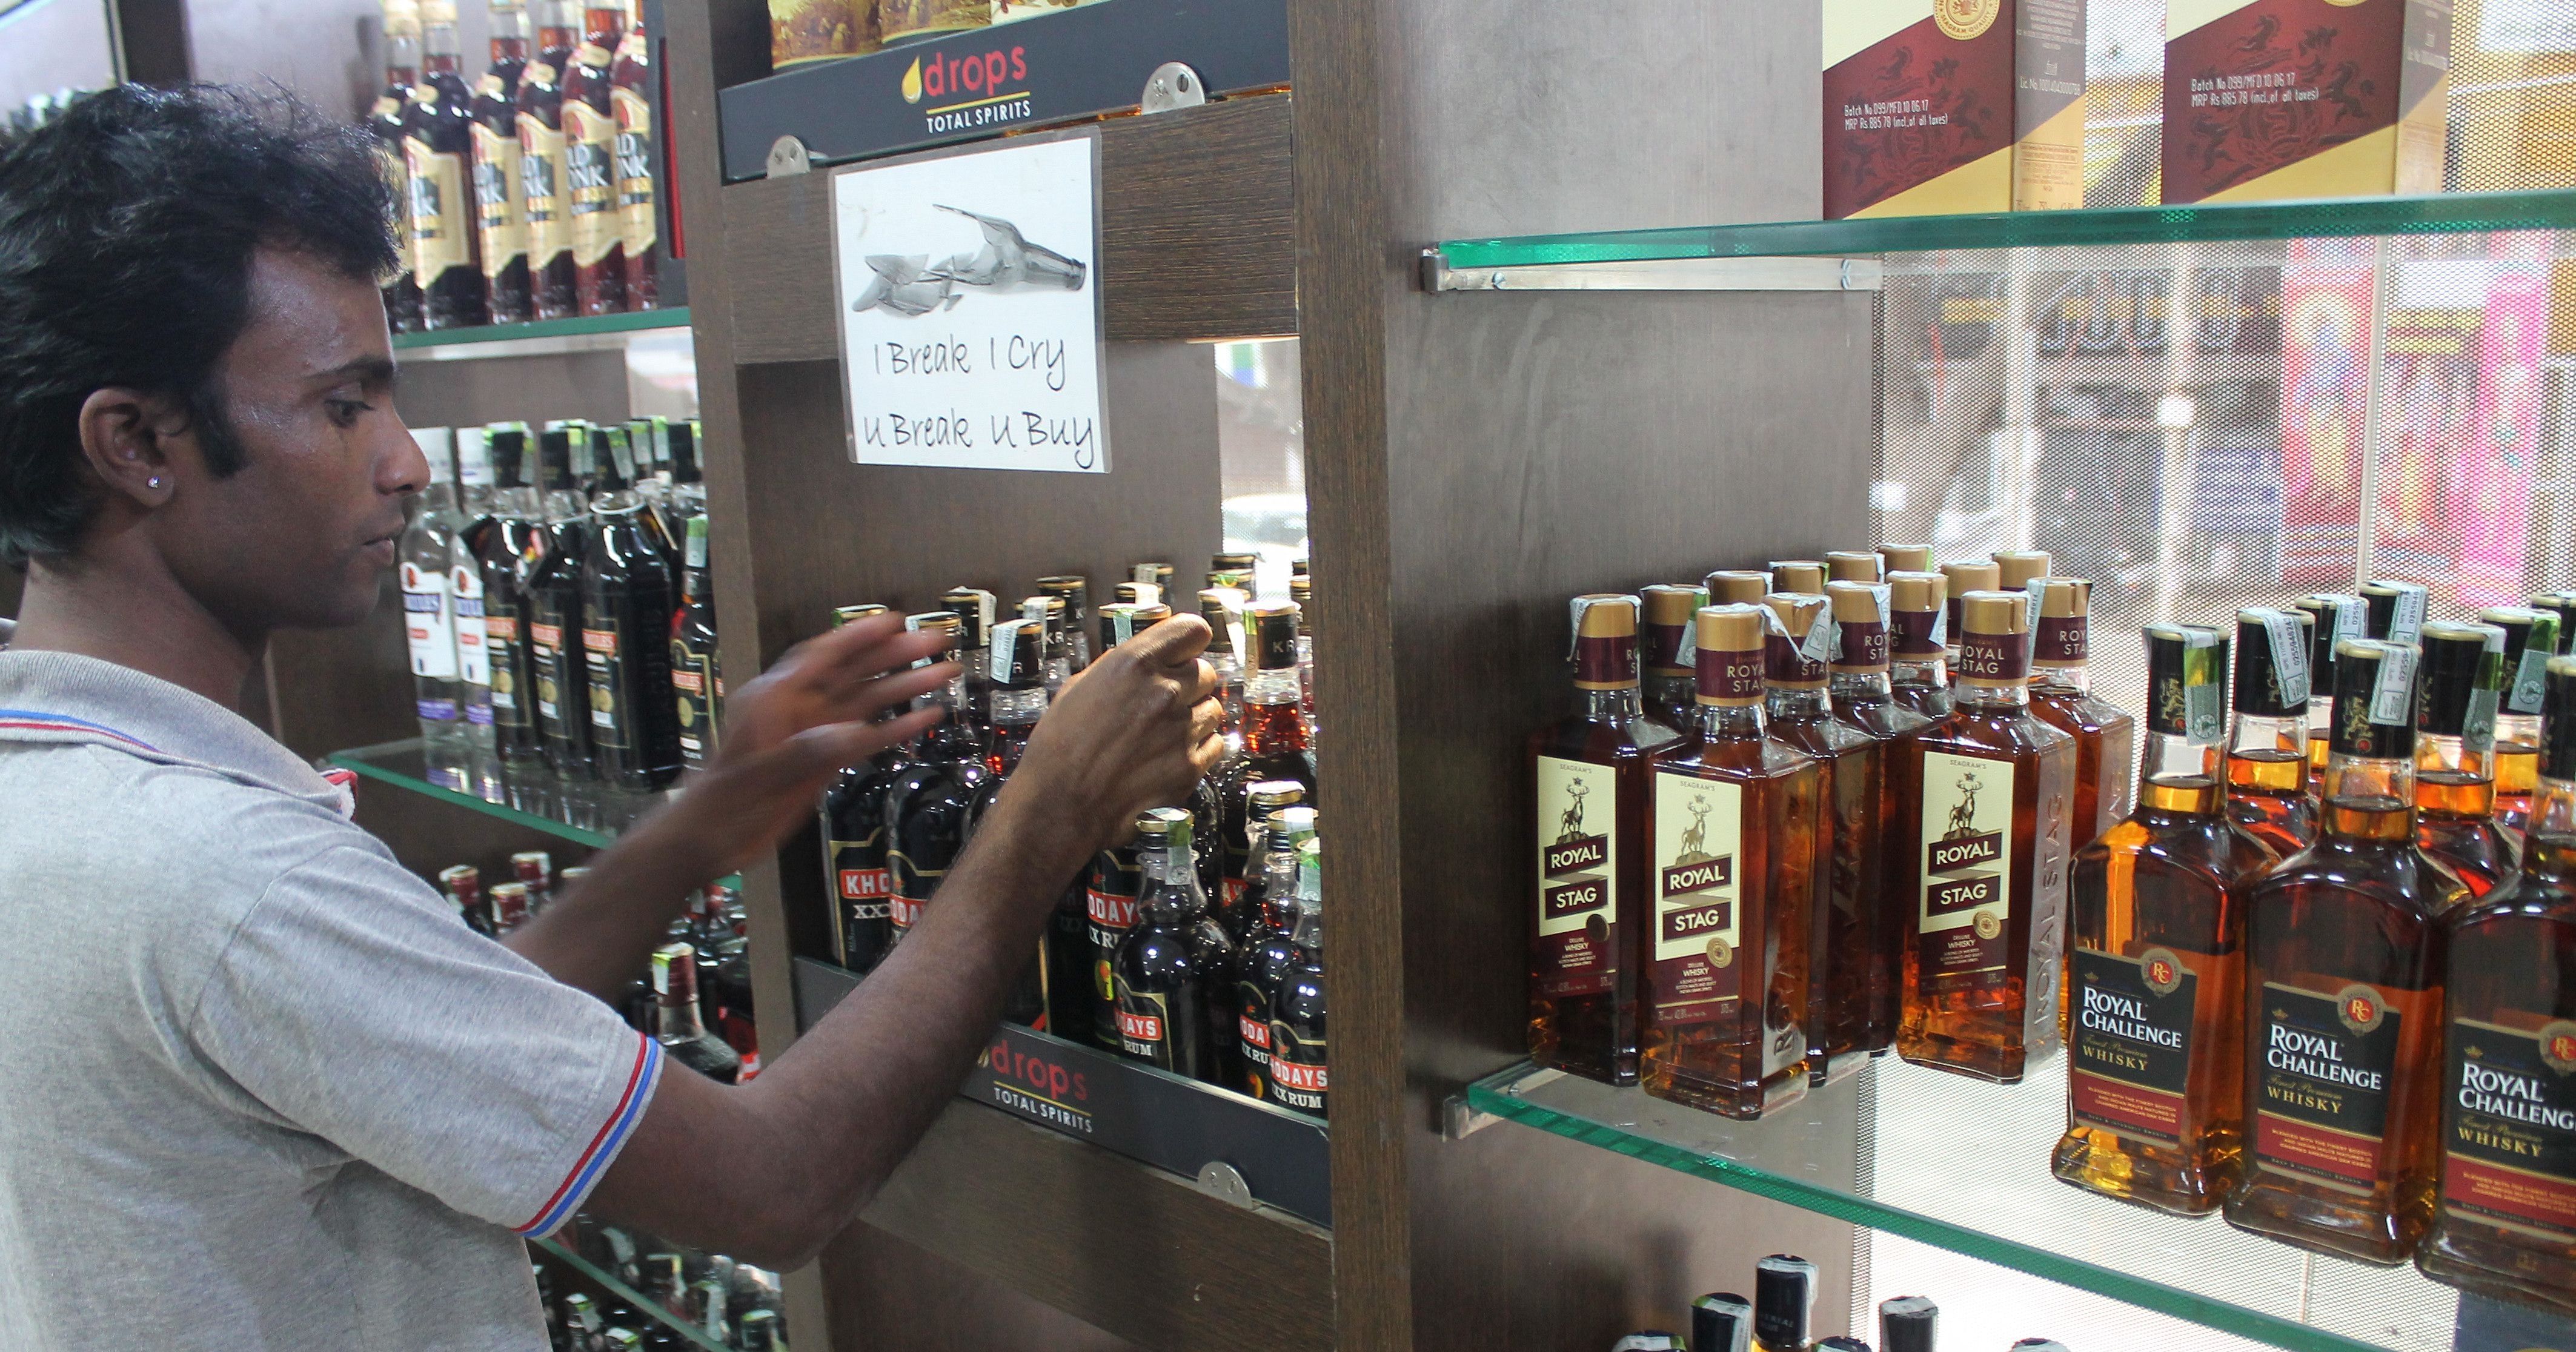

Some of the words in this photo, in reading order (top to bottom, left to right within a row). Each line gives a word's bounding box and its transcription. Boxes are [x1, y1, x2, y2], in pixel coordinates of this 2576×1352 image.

[924, 45, 1027, 97] drops
[926, 111, 972, 134] TOTAL
[975, 100, 1031, 125] SPIRITS
[874, 343, 880, 374] I
[886, 333, 971, 375] Break
[989, 337, 995, 370] I
[1007, 335, 1066, 391] Cry
[889, 408, 972, 448] Break
[1021, 411, 1094, 469] Buy
[2059, 629, 2086, 642] ROY
[2063, 643, 2086, 655] STA
[1727, 664, 1765, 678] ROYA
[1801, 664, 1827, 676] STA
[1962, 658, 1999, 674] STAG
[1560, 763, 1592, 775] SEAGRAM'S
[1950, 760, 1987, 770] SEAGRAM'S
[1680, 780, 1716, 792] SEAGRAM'S
[1551, 845, 1602, 869] ROYAL
[1936, 841, 1995, 865] ROYAL
[1670, 865, 1725, 890] ROYAL
[1556, 887, 1597, 909] STAG
[1940, 883, 1988, 906] STAG
[1675, 909, 1720, 932] STAG
[1682, 967, 1710, 977] WHISKY
[2084, 986, 2147, 1021] ROYAL
[2082, 1010, 2182, 1048] CHALLENGE
[2271, 1024, 2343, 1062] ROYAL
[991, 1039, 1087, 1101] drops
[2082, 1045, 2148, 1072] WHISKY
[2267, 1049, 2382, 1090] CHALLENGE
[2462, 1061, 2544, 1102] ROYAL
[994, 1087, 1037, 1114] TOTAL
[1040, 1104, 1092, 1133] SPIRITS
[1288, 1092, 1323, 1108] RUM
[2267, 1085, 2343, 1115] WHISKY
[2458, 1087, 2576, 1132] CHALLENG
[2458, 1127, 2544, 1158] WHISKY
